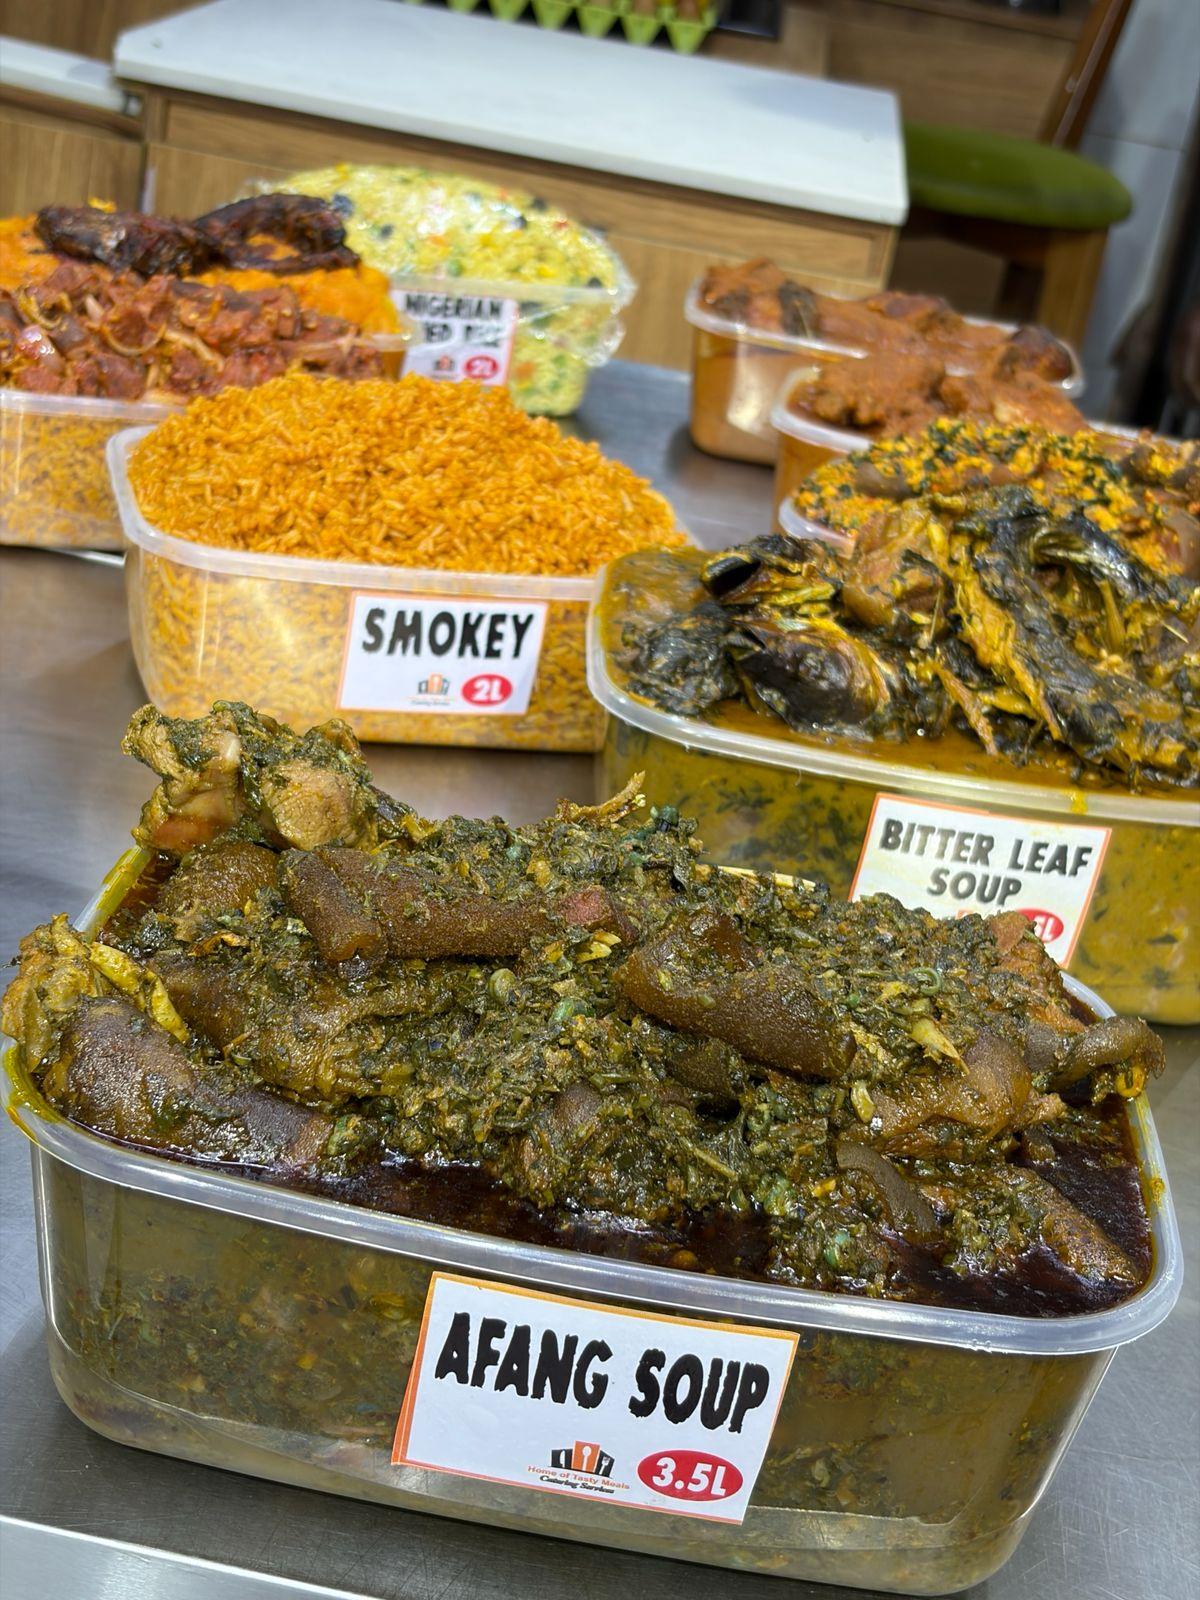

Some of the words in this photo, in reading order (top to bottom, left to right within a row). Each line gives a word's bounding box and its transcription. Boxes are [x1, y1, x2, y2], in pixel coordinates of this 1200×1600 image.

[406, 293, 502, 319] NIGERIAN
[362, 607, 534, 660] SMOKEY
[472, 679, 503, 702] 2L
[879, 817, 995, 867] BITTER
[1007, 838, 1093, 877] LEAF
[926, 866, 1023, 907] SOUP
[434, 1311, 614, 1410] AFANG
[628, 1348, 770, 1434] SOUP
[527, 1465, 557, 1476] Home
[572, 1473, 599, 1485] Tasty
[601, 1479, 631, 1490] Meals
[539, 1475, 580, 1489] Catering
[579, 1482, 615, 1494] Services
[651, 1456, 727, 1497] 3.5L
